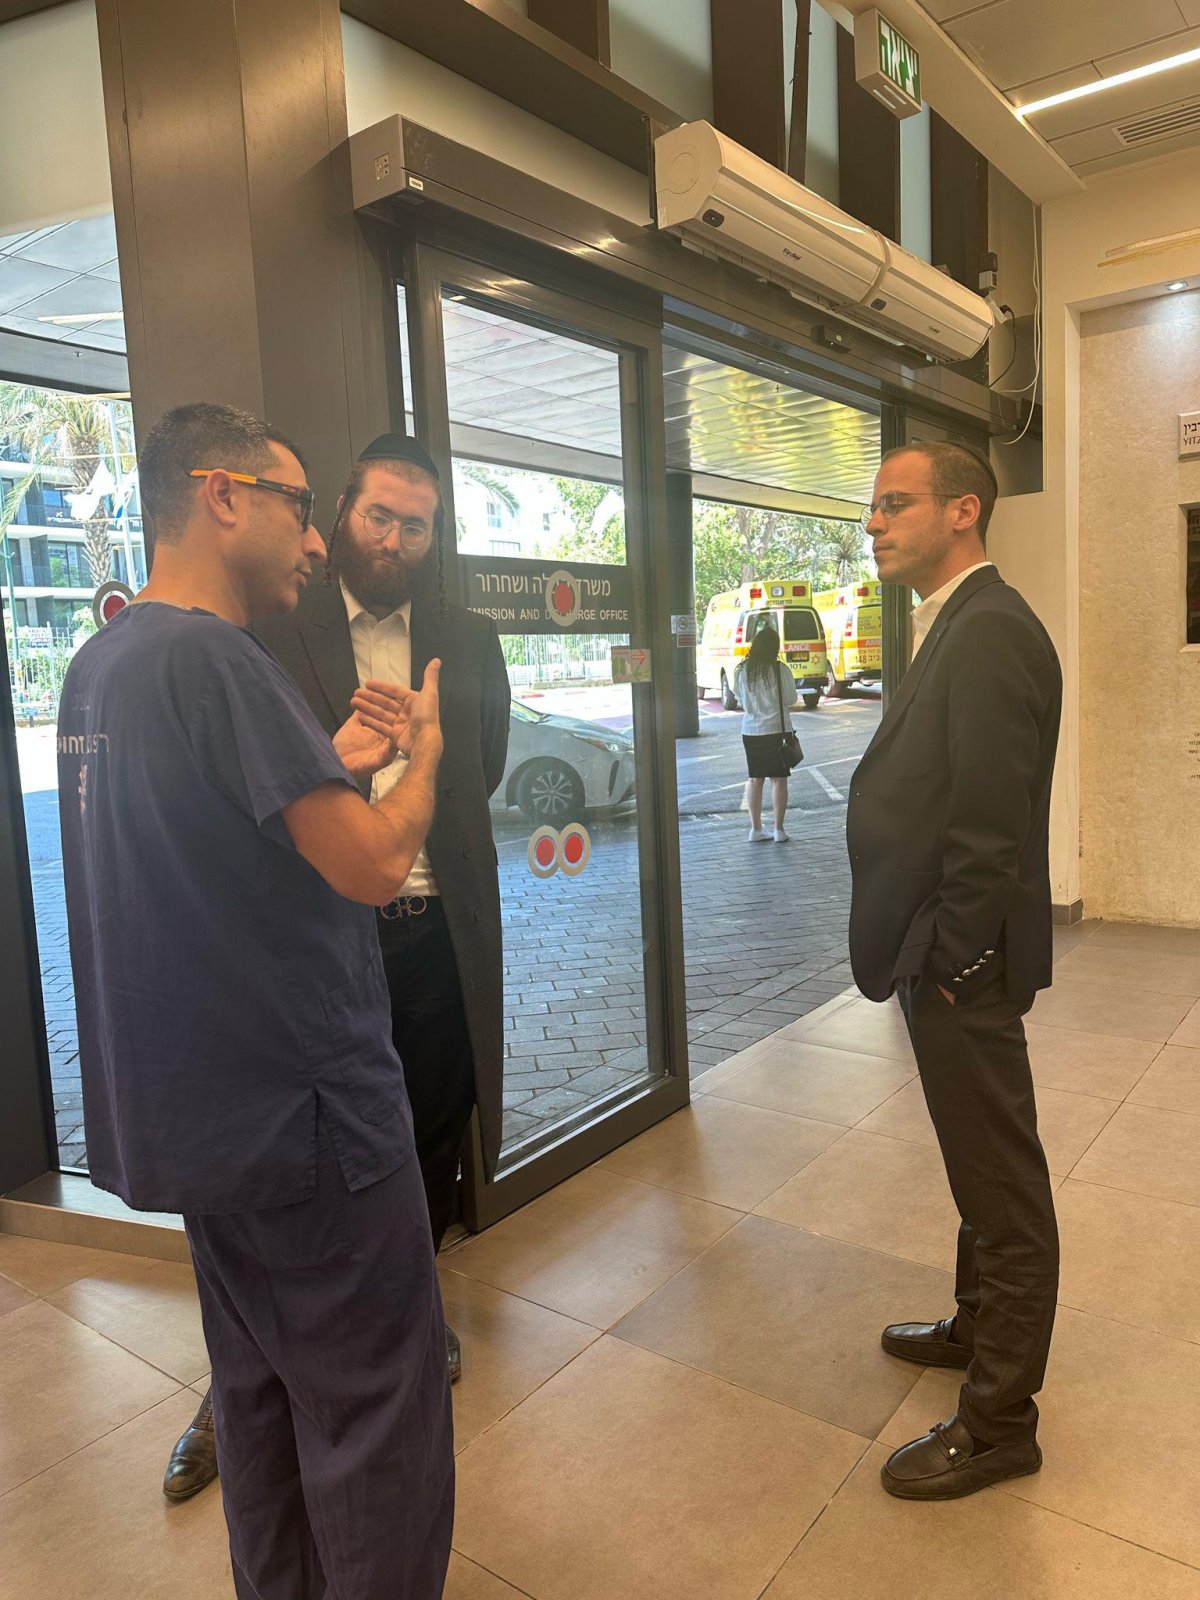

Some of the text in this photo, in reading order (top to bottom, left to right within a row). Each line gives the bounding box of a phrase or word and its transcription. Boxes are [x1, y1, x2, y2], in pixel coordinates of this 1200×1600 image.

[476, 573, 529, 594] ושחרור
[520, 609, 540, 620] AND
[600, 609, 628, 621] OFFICE
